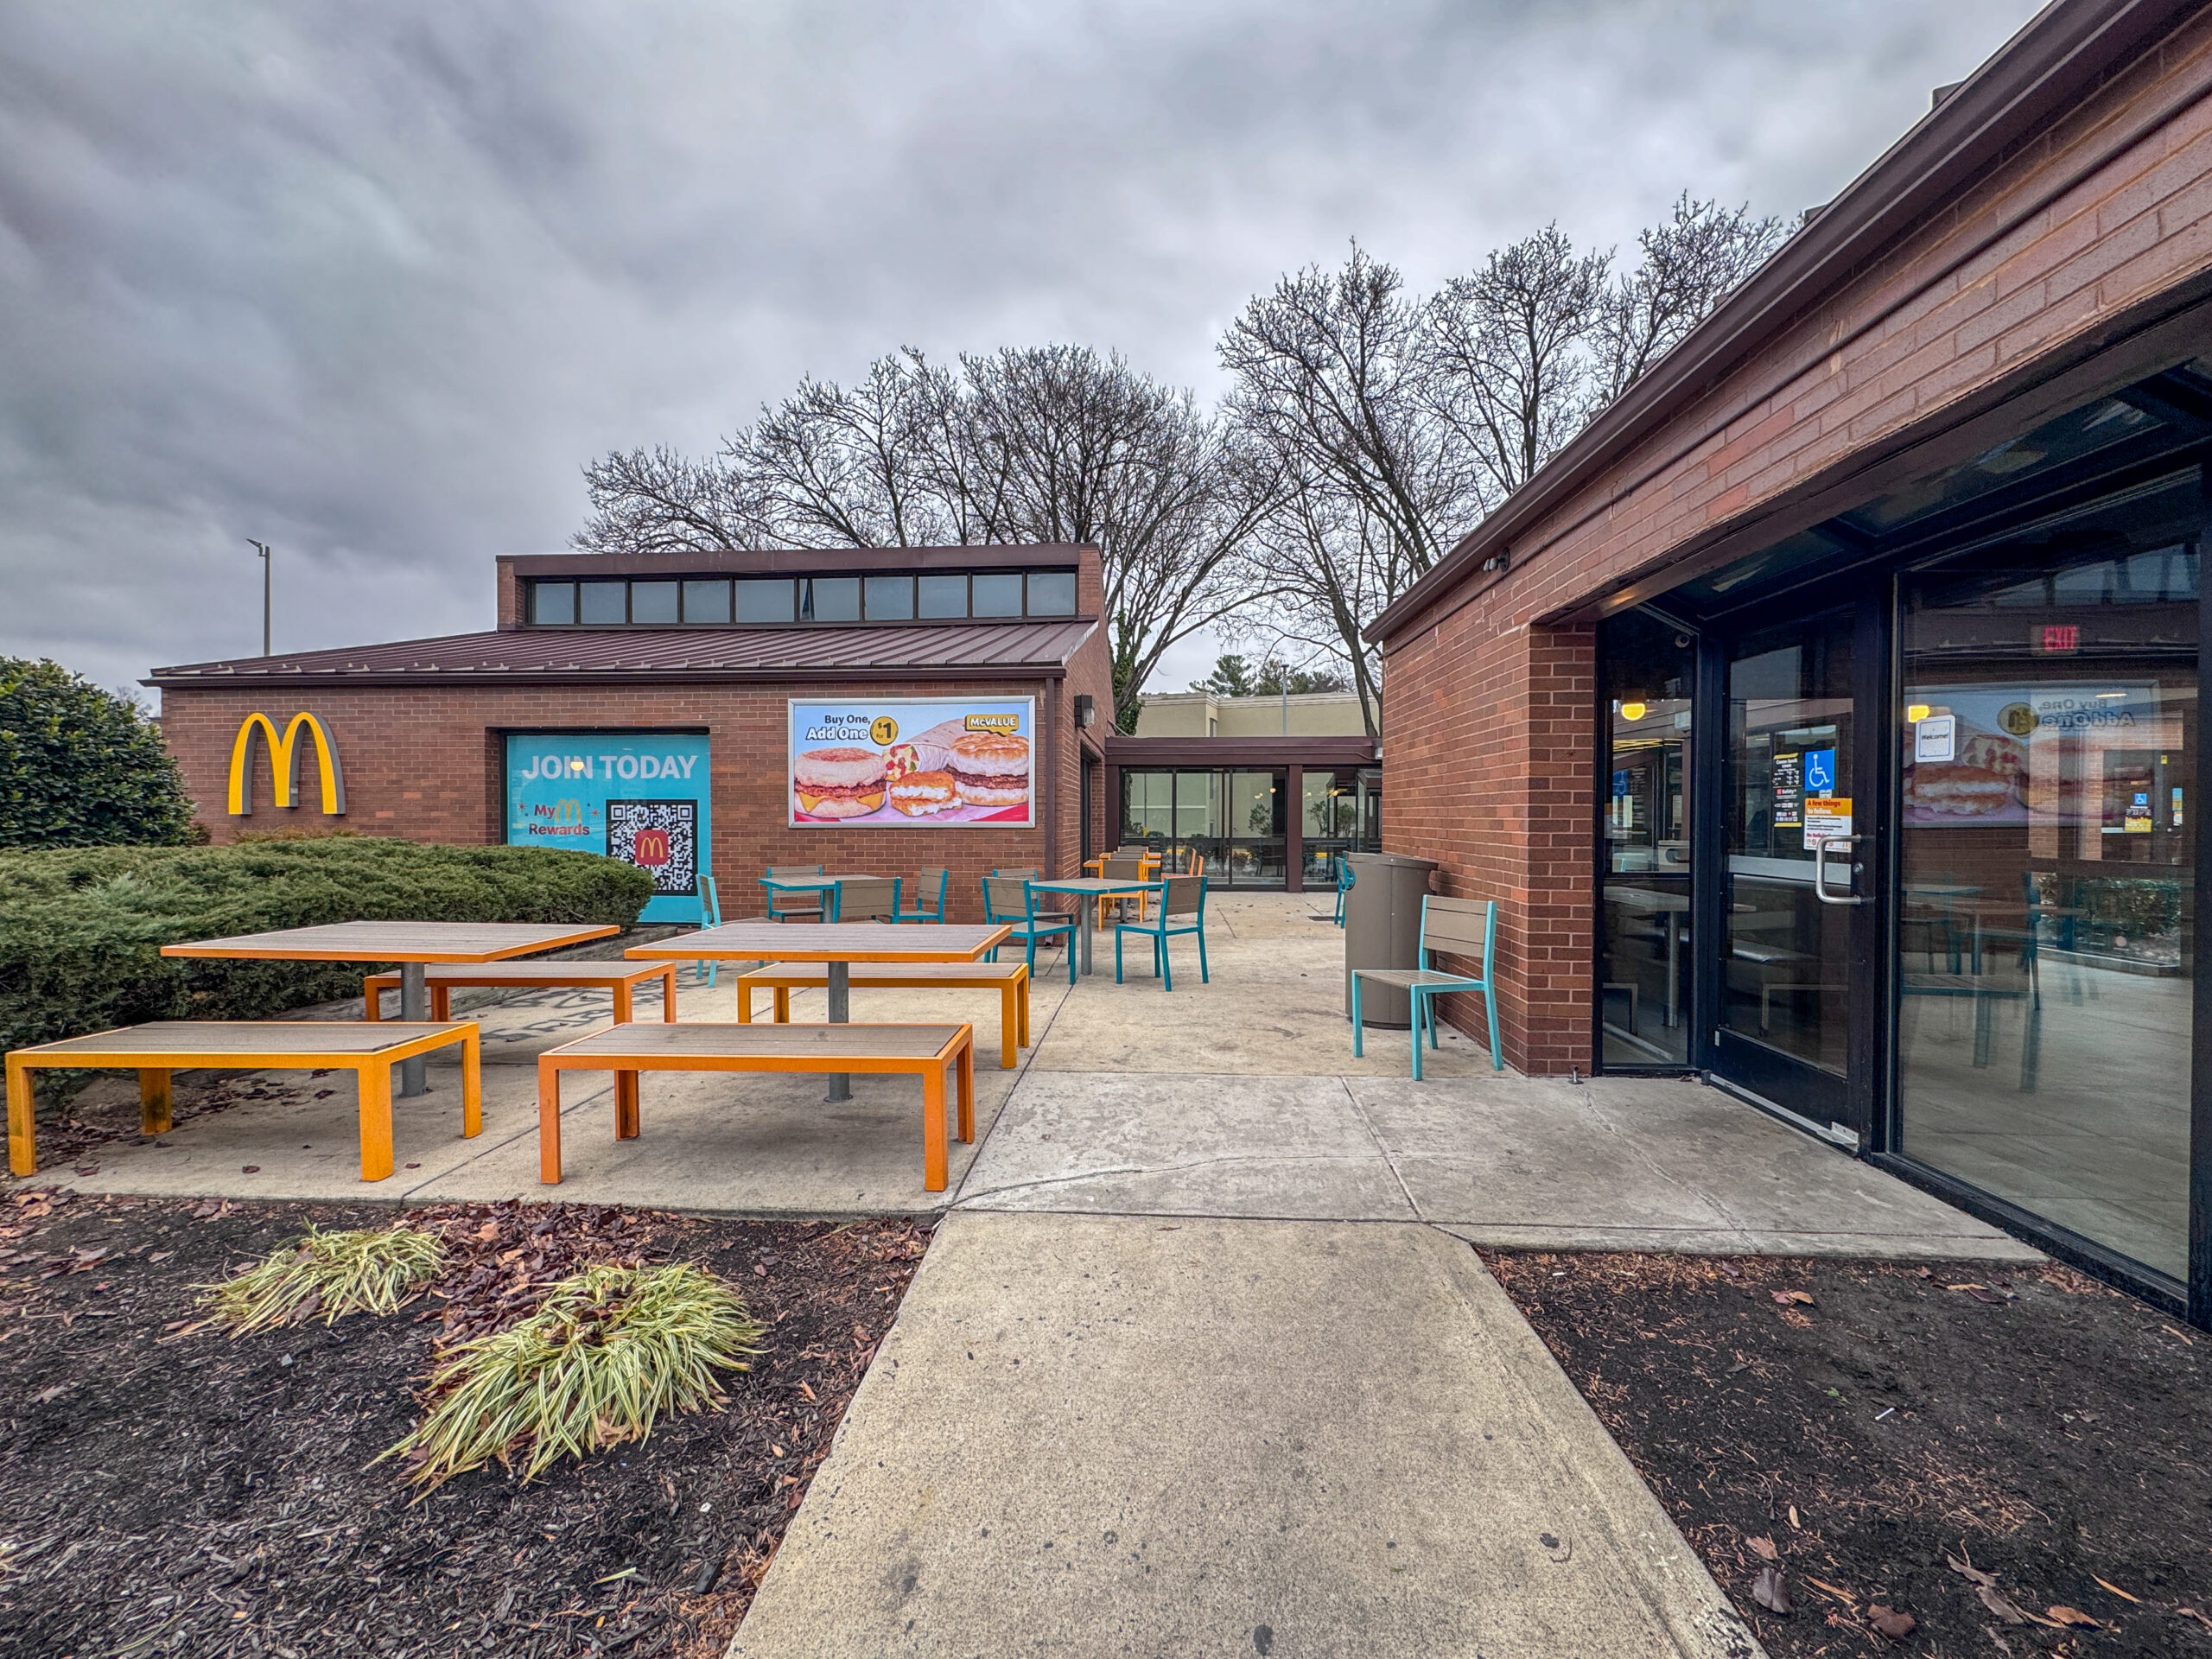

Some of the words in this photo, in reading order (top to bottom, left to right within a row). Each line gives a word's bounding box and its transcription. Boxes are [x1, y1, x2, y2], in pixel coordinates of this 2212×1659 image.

[2044, 626, 2076, 650] EXIT
[824, 715, 844, 726] Buy
[847, 715, 871, 724] One,
[969, 718, 1016, 727] McVALUE
[805, 727, 836, 741] Add
[837, 727, 868, 741] One
[522, 755, 594, 779] JOIN
[599, 755, 698, 779] TODAY
[534, 804, 556, 819] My
[529, 823, 590, 836] Rewards
